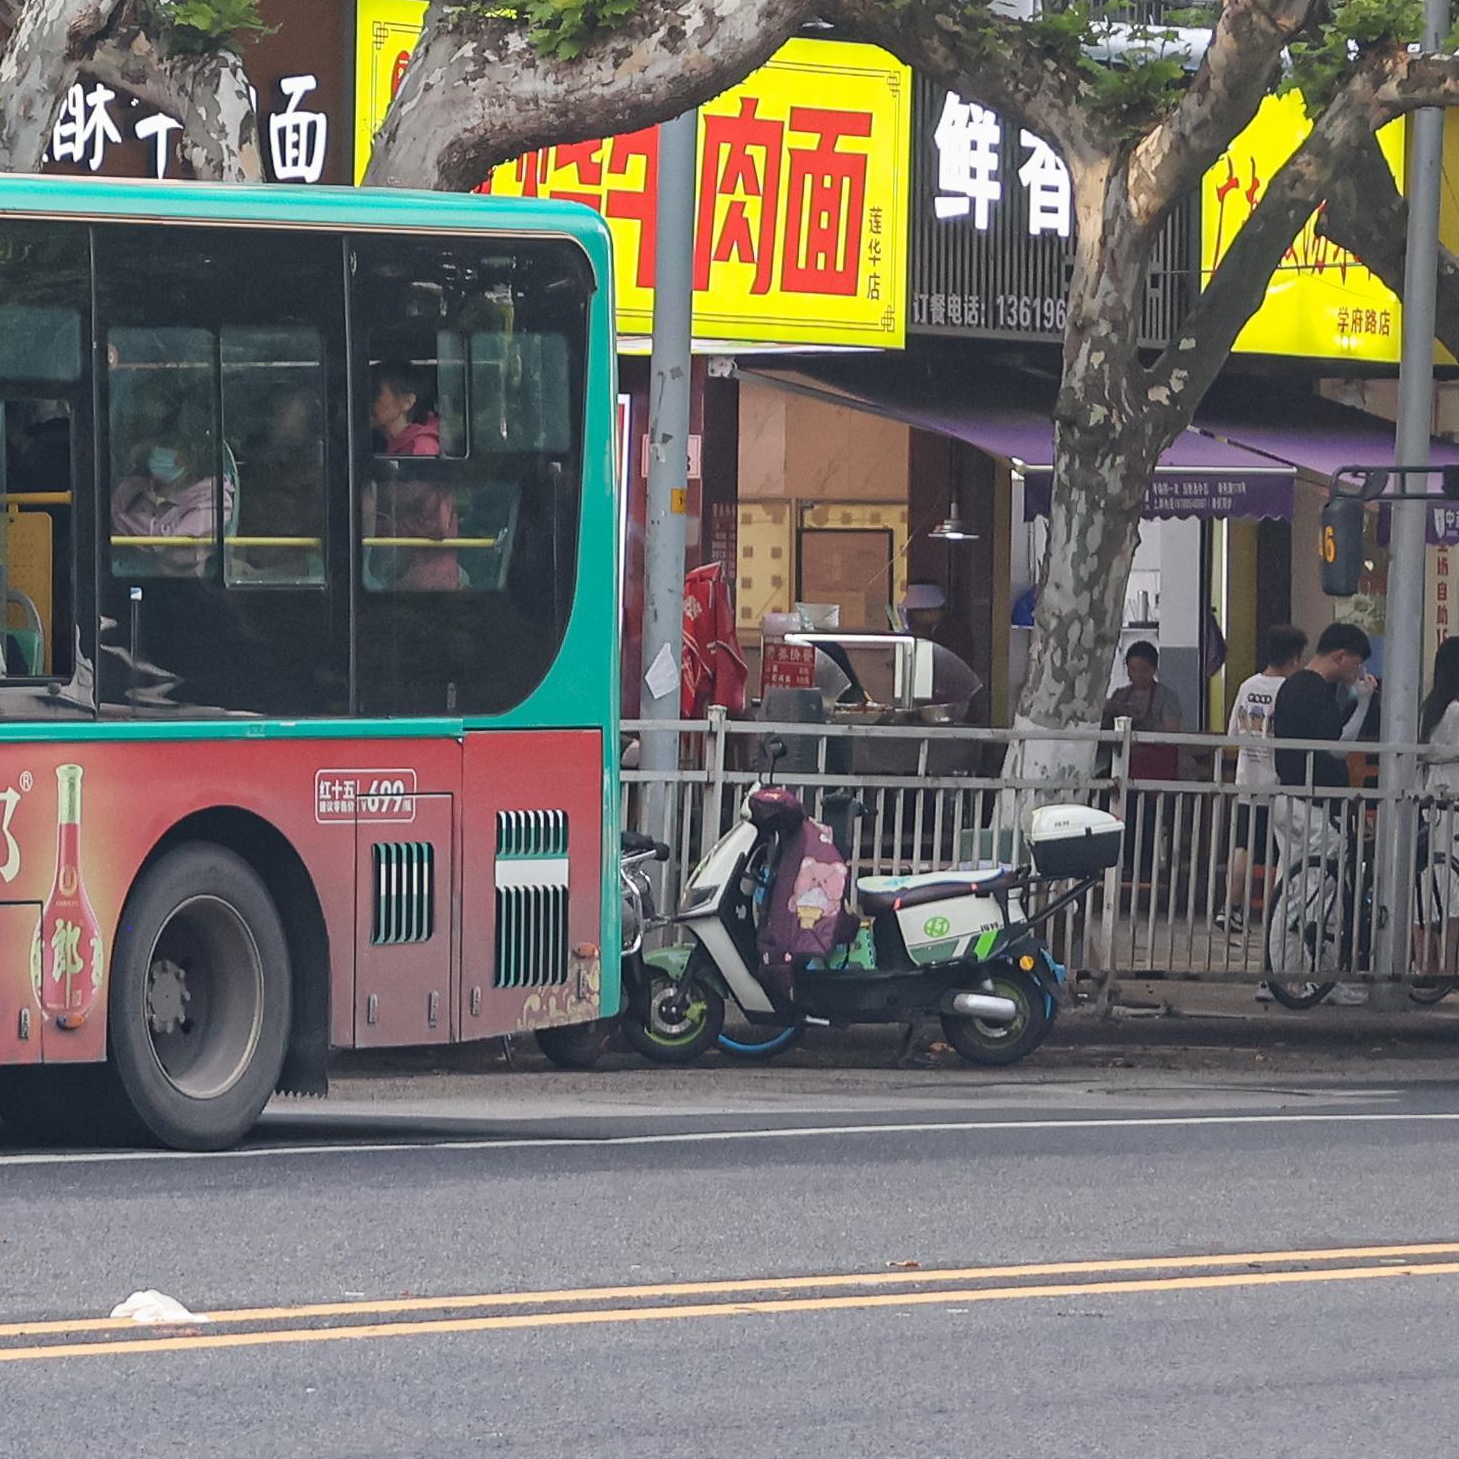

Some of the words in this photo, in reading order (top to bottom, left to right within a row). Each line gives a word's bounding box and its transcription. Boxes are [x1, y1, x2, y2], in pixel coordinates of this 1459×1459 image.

[865, 206, 883, 300] 莲华店
[1338, 307, 1390, 336] 学府路店
[319, 779, 356, 799] 红十五
